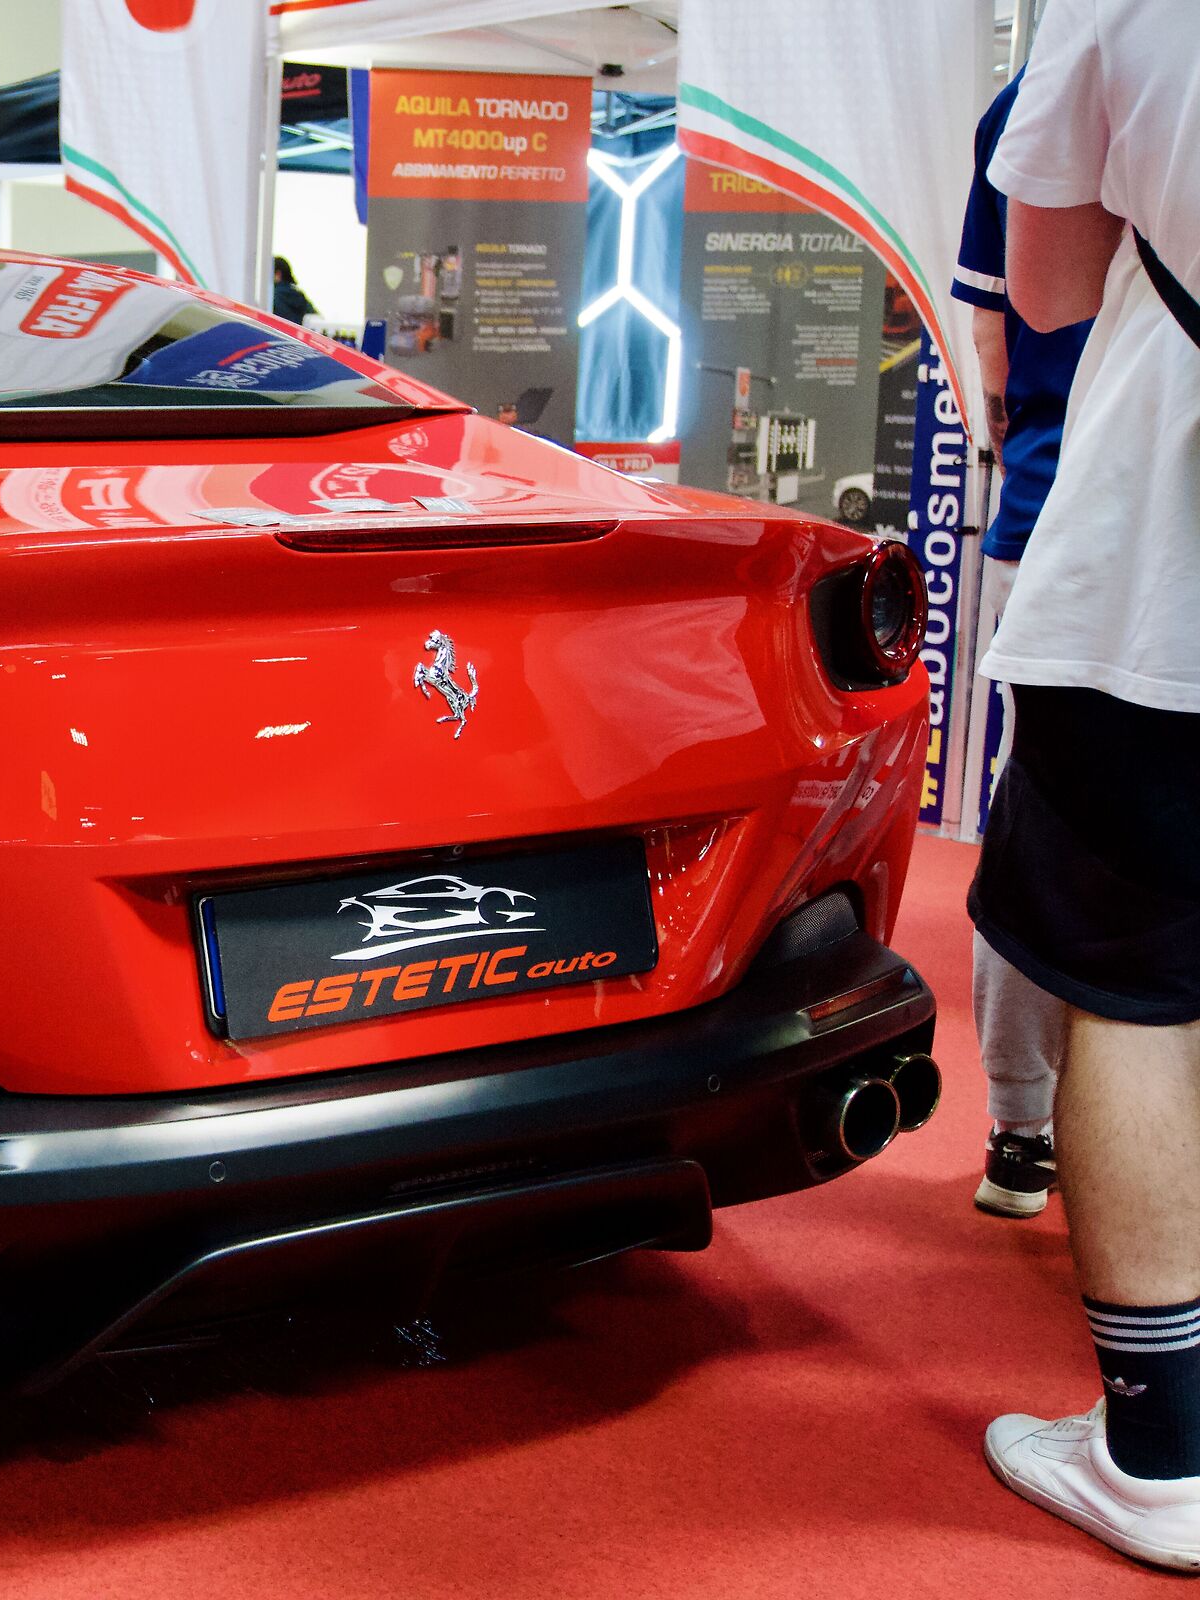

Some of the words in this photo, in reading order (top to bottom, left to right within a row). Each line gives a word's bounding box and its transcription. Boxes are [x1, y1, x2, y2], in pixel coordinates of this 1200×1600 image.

[282, 72, 321, 89] uto
[395, 96, 471, 116] AQUILA
[475, 98, 569, 121] TORNADO
[531, 132, 548, 152] C
[392, 164, 498, 180] ABBINAMENTO
[500, 167, 566, 182] PERFETTO
[705, 232, 794, 252] SINERGIA
[800, 234, 865, 253] TOTALE
[267, 945, 531, 1022] ESTETIC
[526, 950, 618, 980] auto
